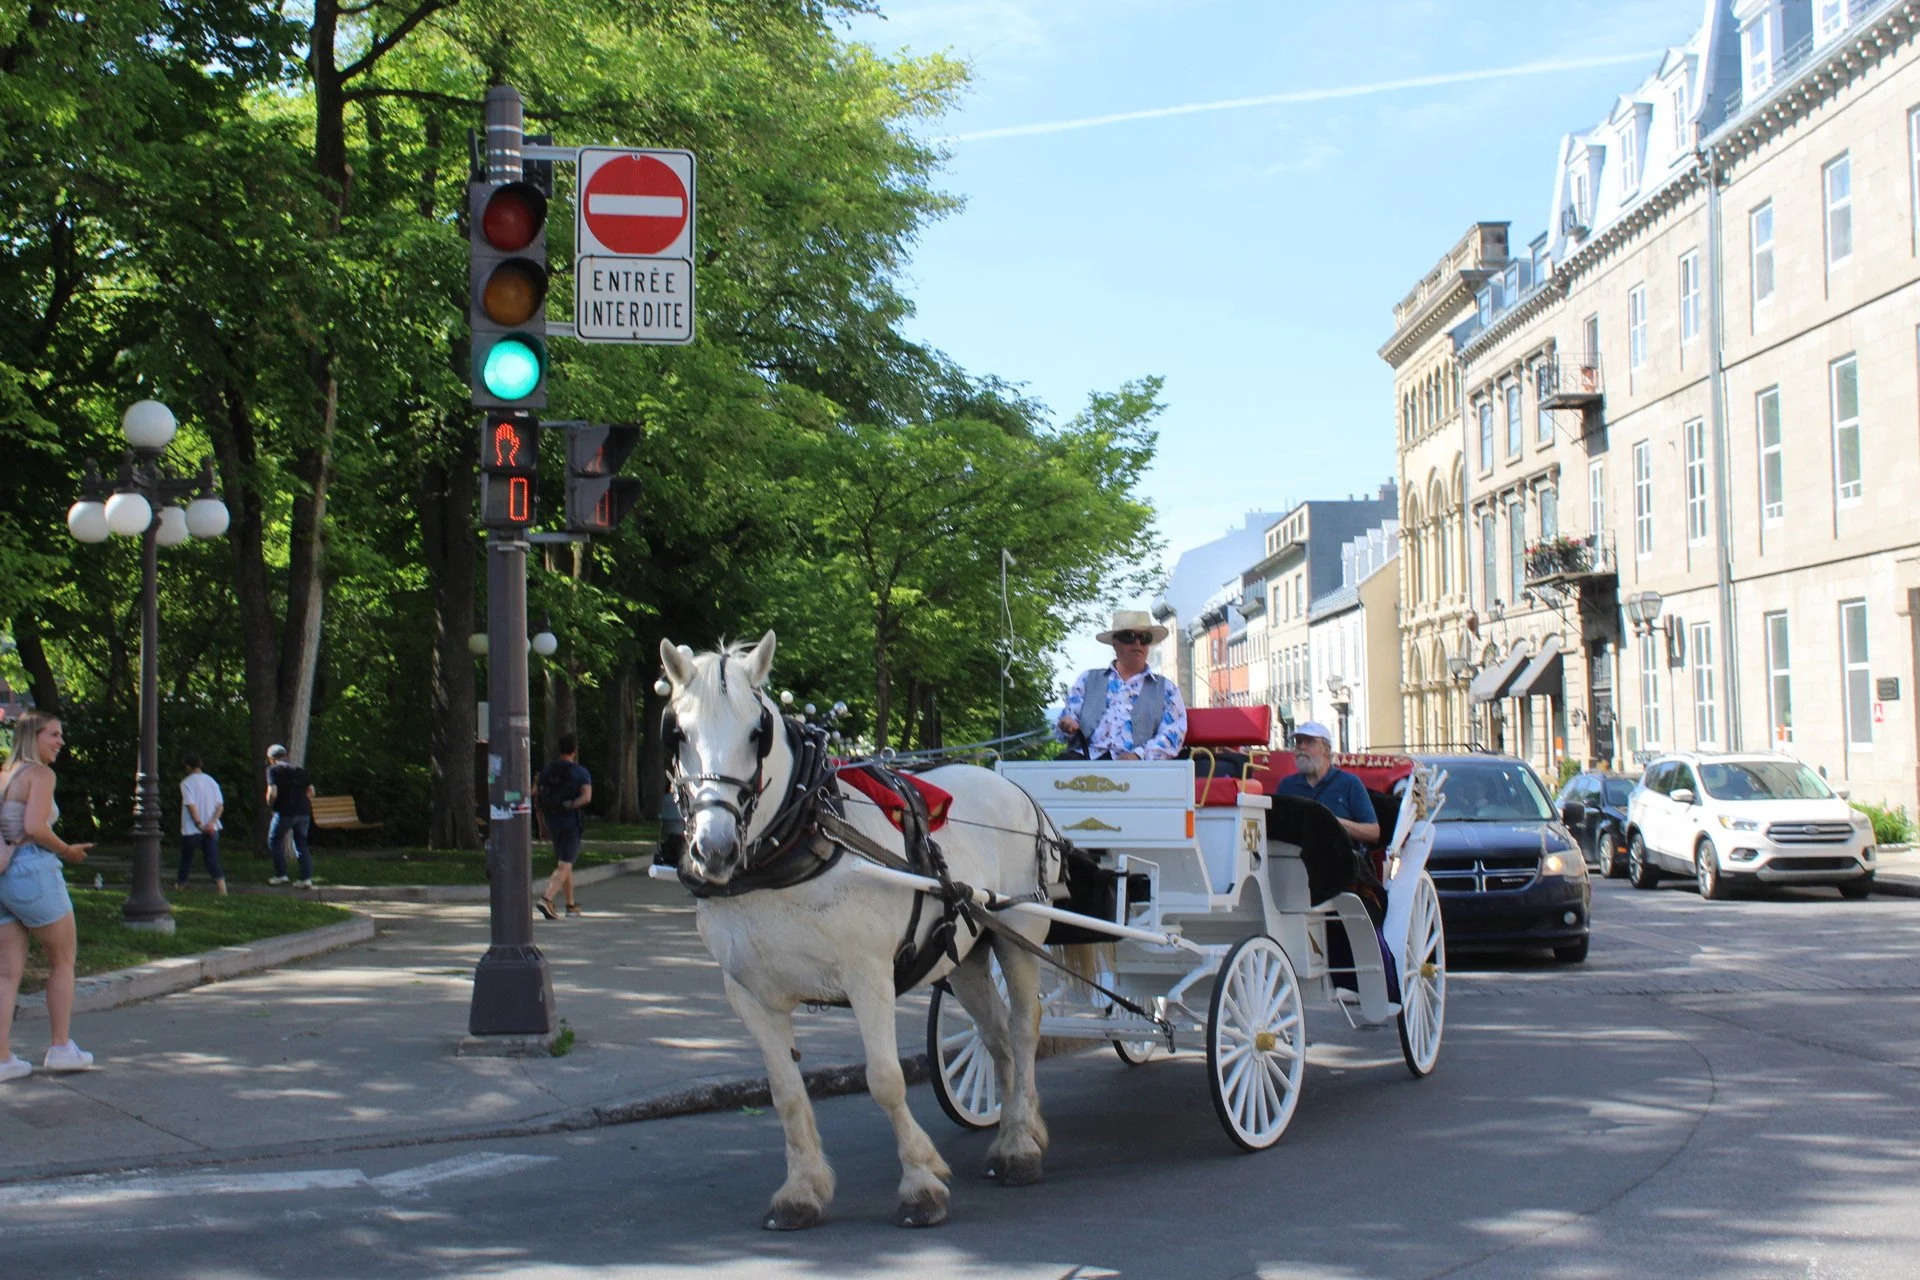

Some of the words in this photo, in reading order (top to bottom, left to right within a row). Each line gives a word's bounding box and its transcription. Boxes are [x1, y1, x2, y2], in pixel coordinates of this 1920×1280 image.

[593, 267, 676, 294] ENTRÉE
[584, 300, 683, 328] INTERDITE
[509, 477, 529, 522] 0
